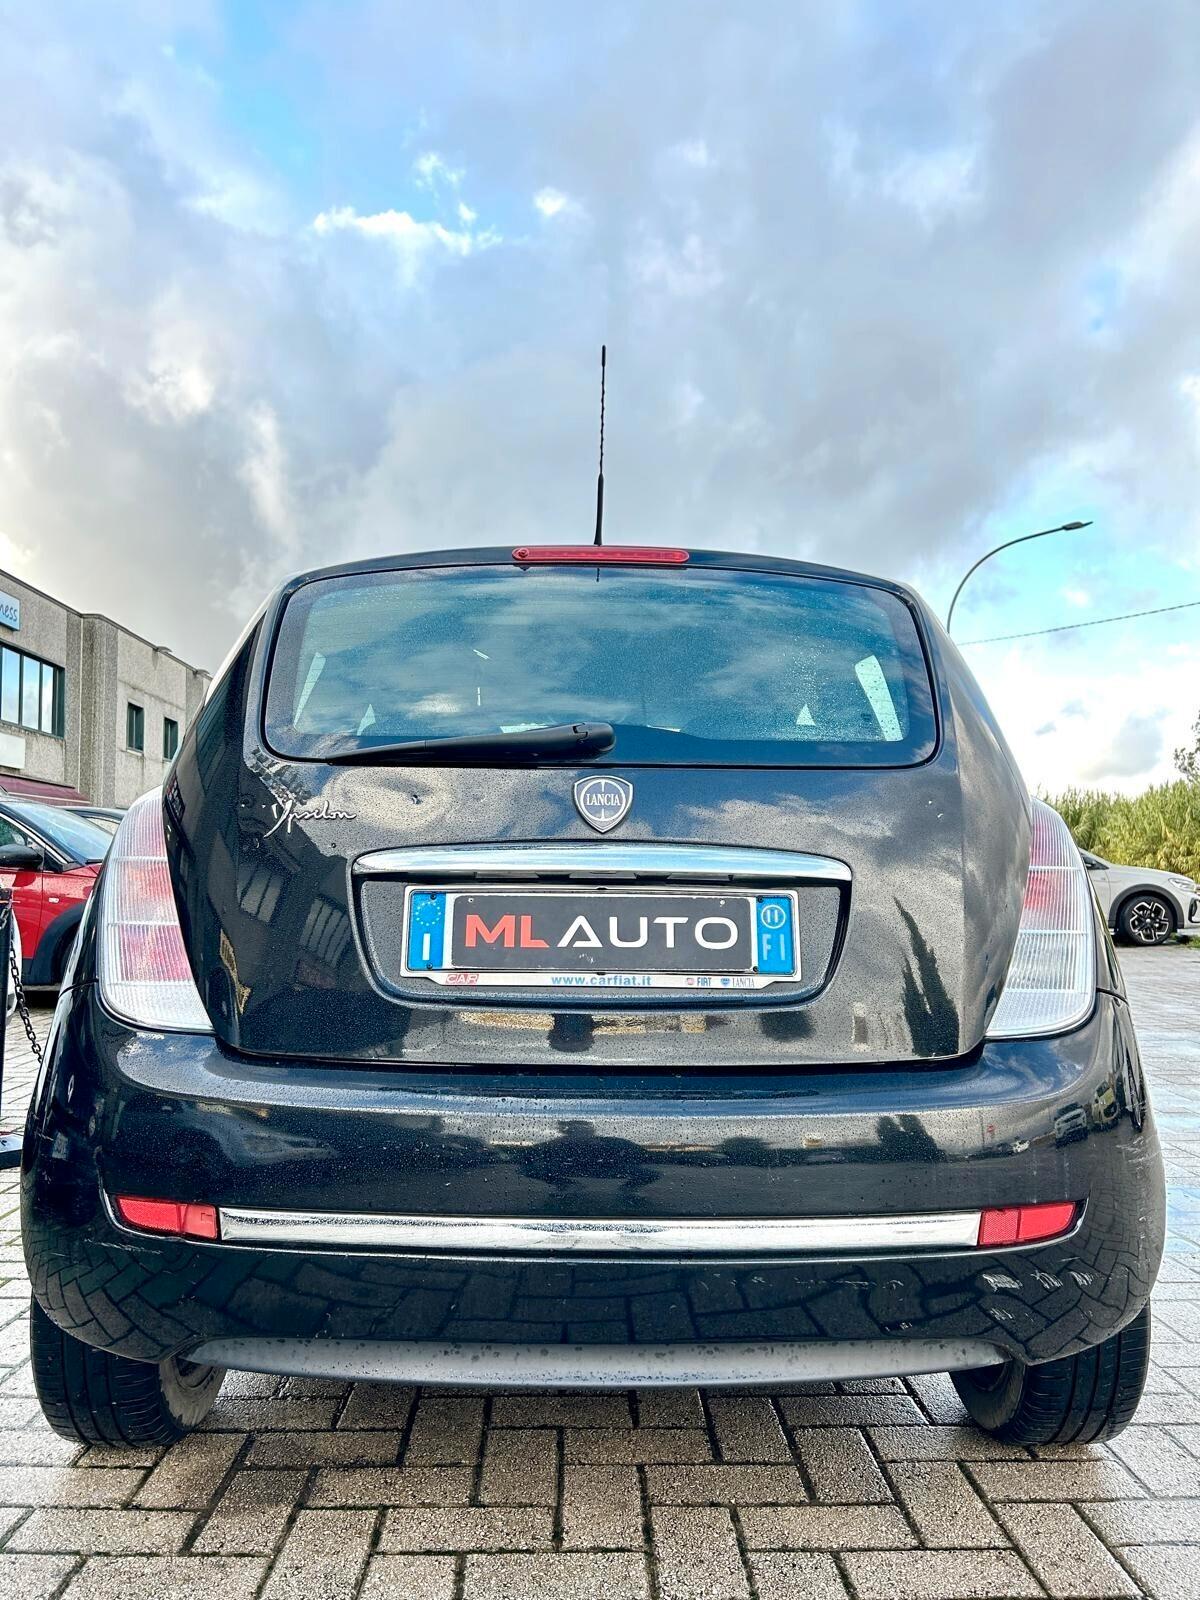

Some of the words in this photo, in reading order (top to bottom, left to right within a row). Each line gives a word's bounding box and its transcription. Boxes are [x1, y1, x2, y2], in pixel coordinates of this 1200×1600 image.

[585, 793, 621, 806] LANCIA
[264, 799, 357, 839] Ypsilon
[445, 973, 480, 985] CAR
[551, 975, 652, 986] www.carfiat.it
[697, 977, 712, 987] FIAT
